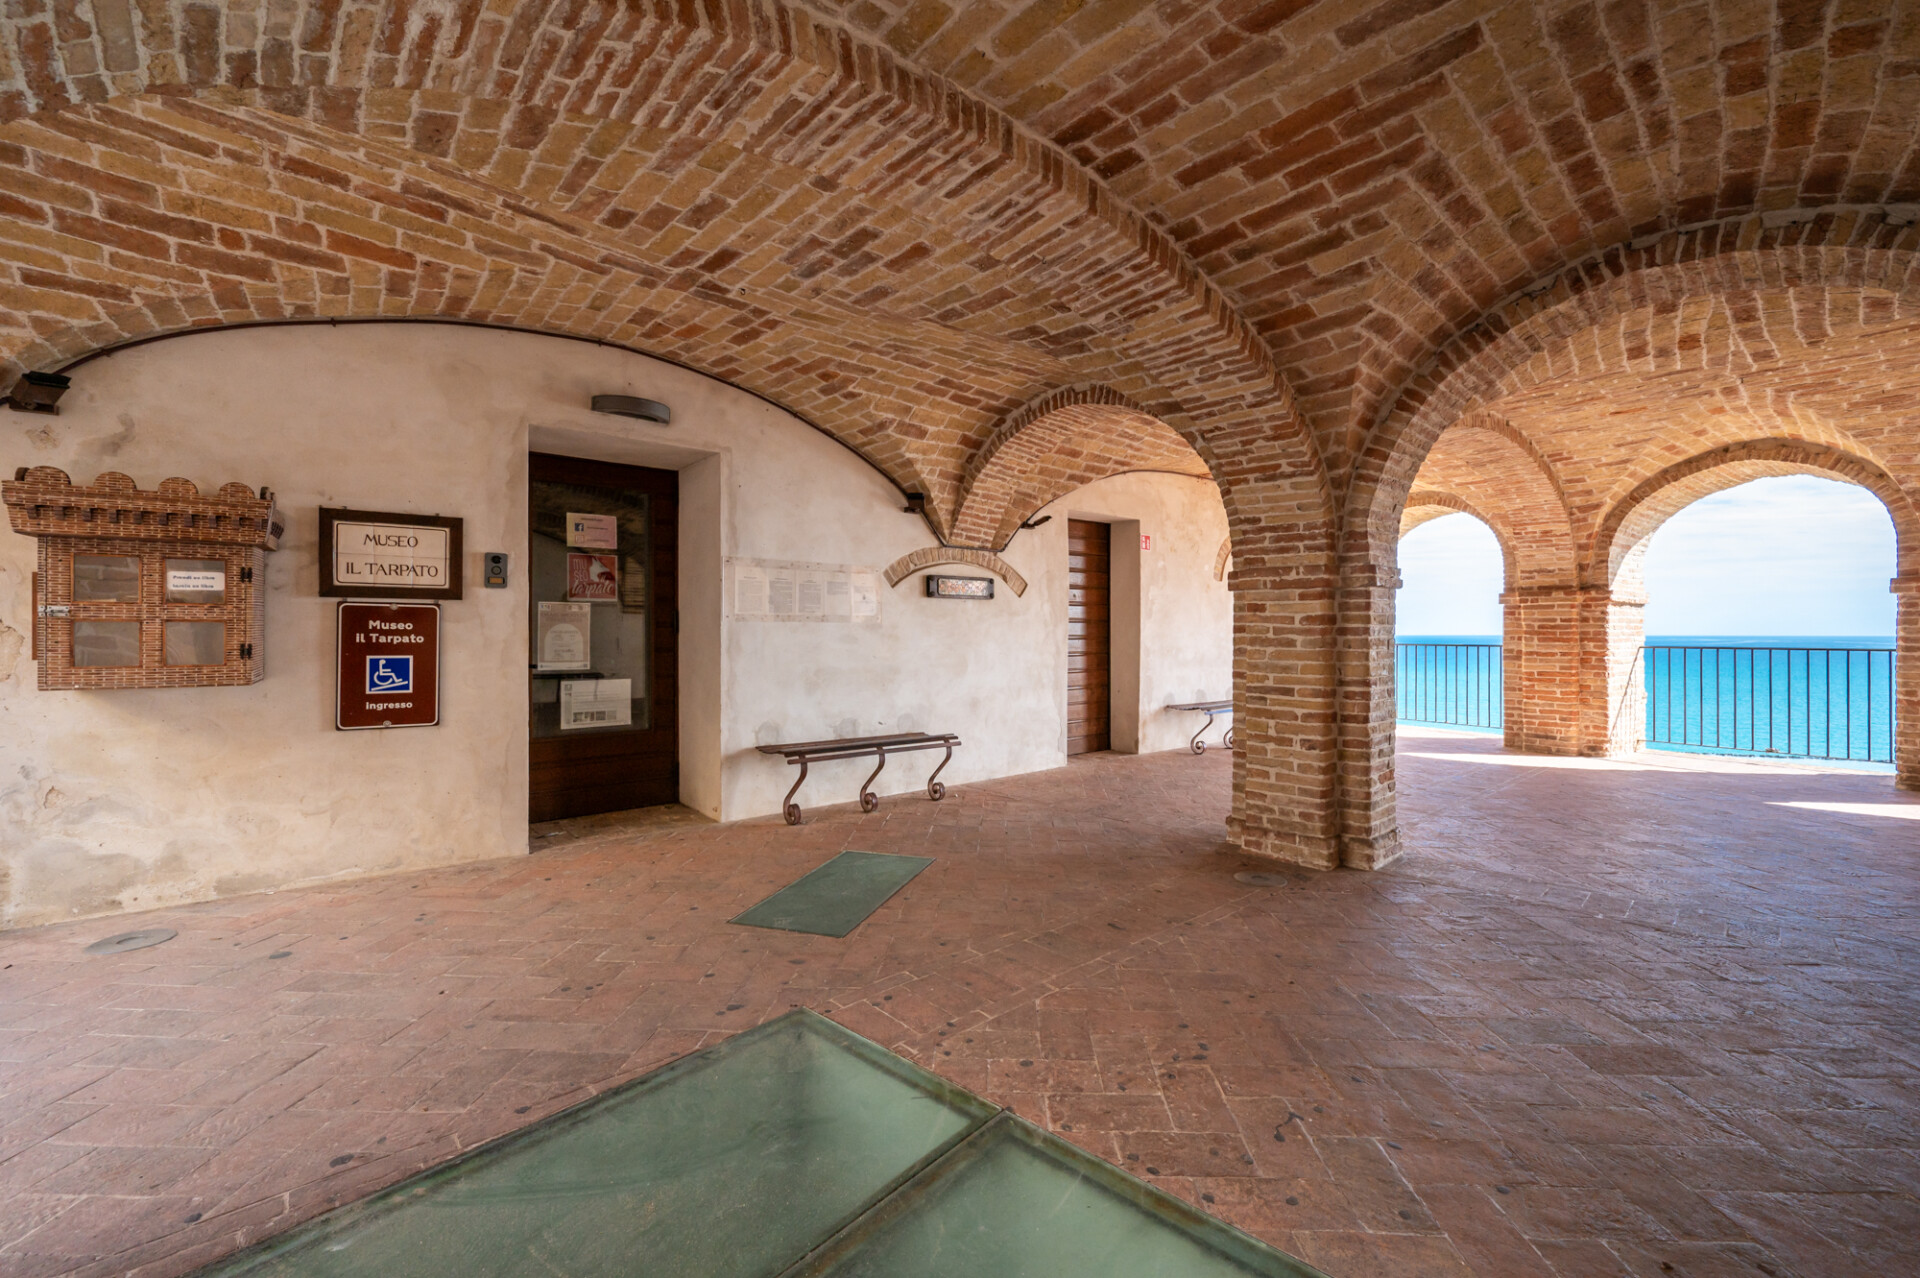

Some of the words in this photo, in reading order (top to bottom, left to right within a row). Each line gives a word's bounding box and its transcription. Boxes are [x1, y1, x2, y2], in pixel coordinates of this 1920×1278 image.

[363, 534, 418, 548] MUSEO
[346, 562, 361, 575] IL
[365, 563, 438, 577] TARPATO
[368, 620, 413, 630] Museo
[369, 633, 424, 645] Tarpato
[365, 702, 413, 711] ingresso
